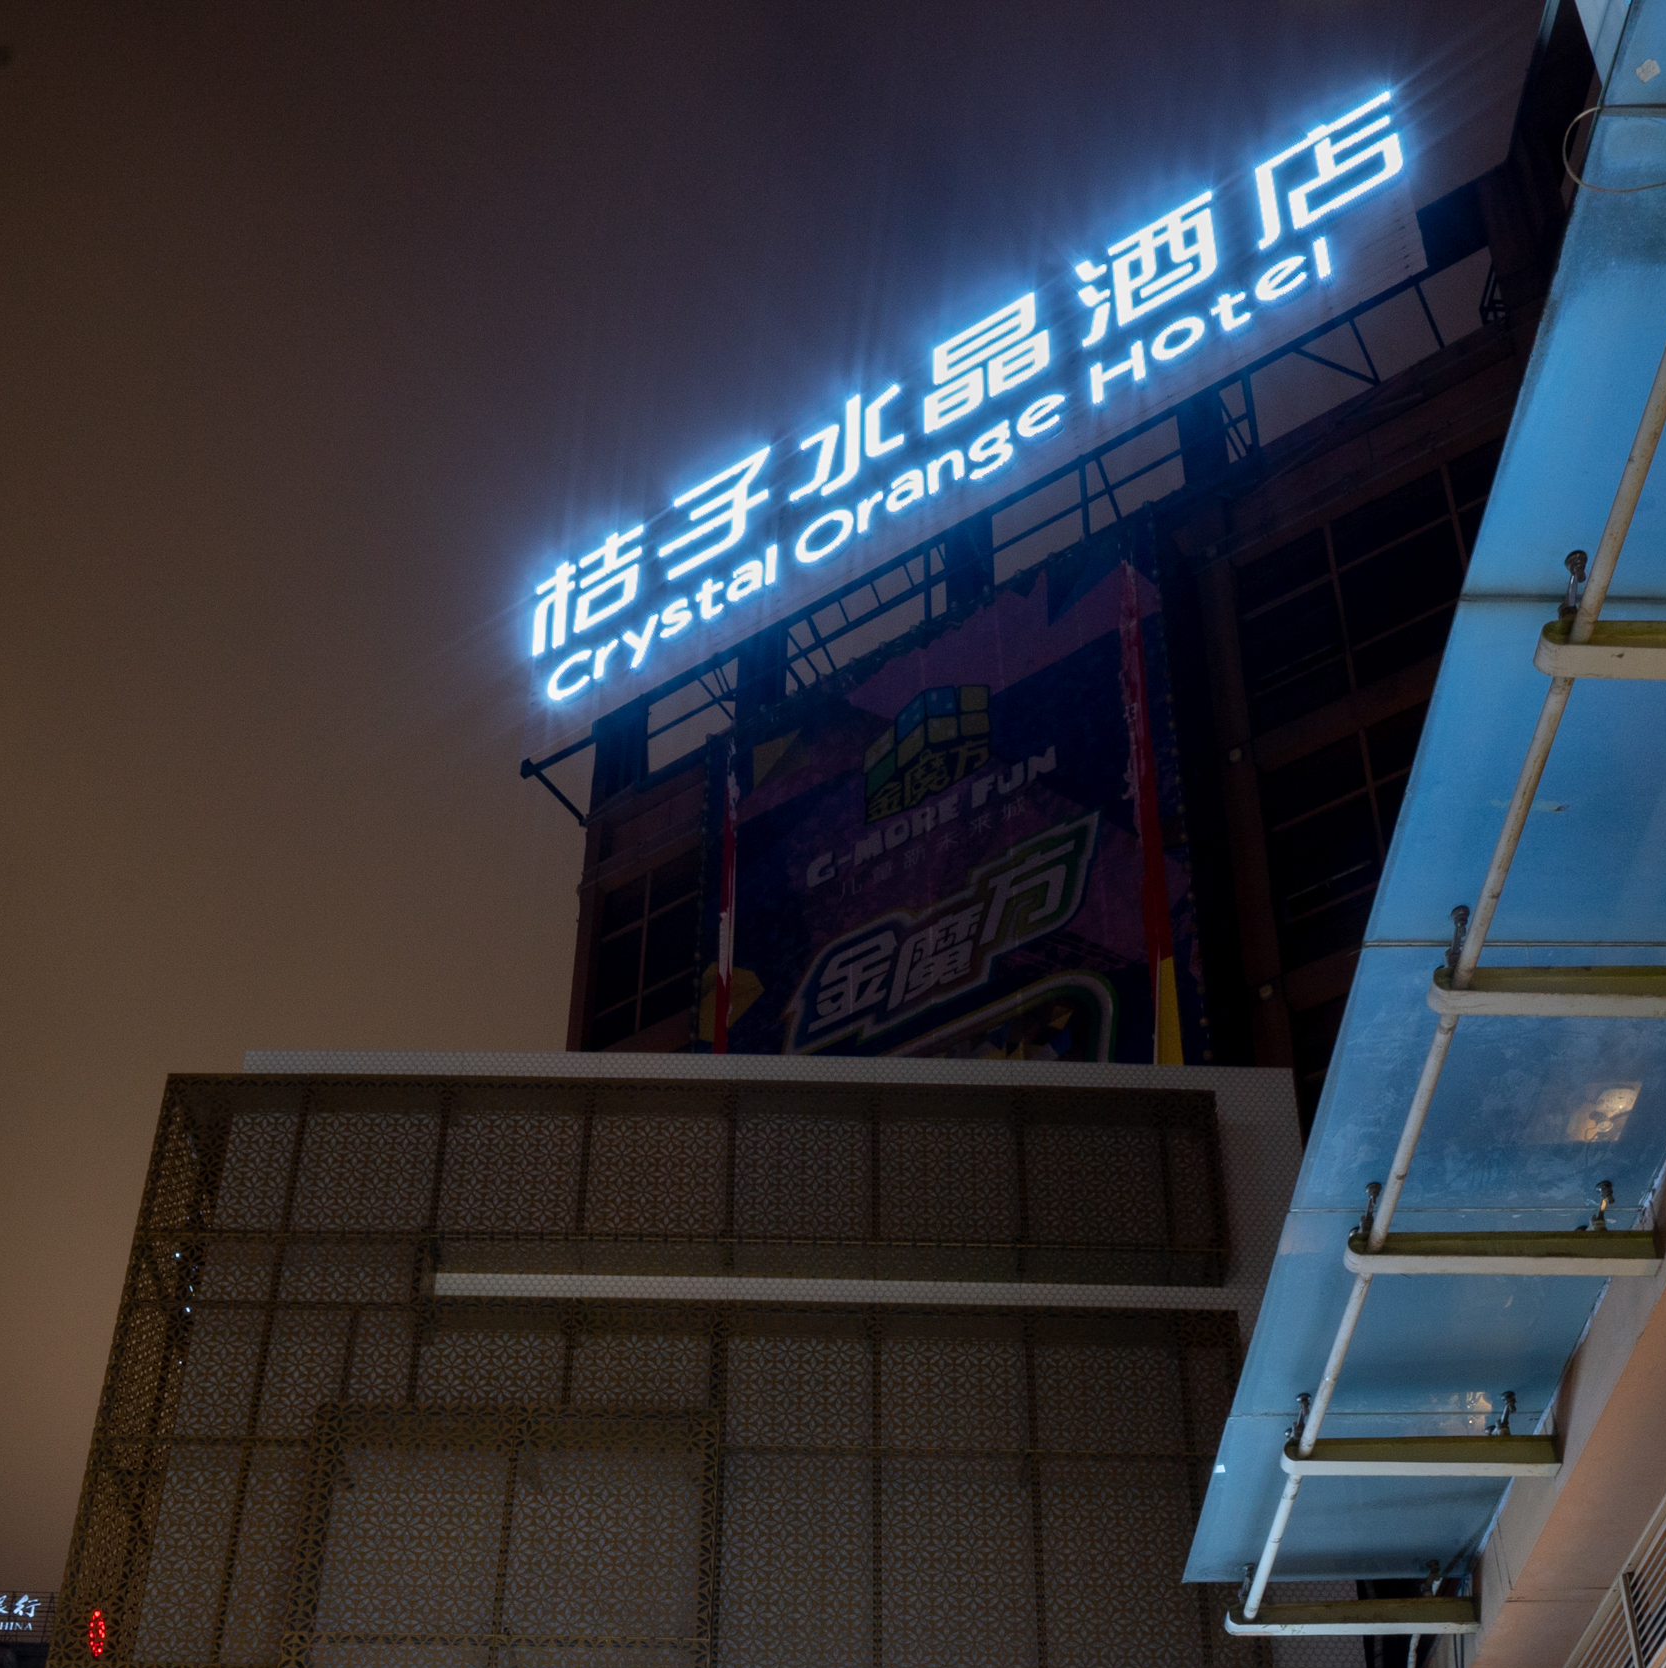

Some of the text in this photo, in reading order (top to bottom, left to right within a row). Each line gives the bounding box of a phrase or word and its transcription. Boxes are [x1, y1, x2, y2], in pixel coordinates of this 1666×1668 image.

[531, 90, 1405, 656] 桔子水晶酒店
[546, 237, 1332, 702] Crystal Orange Hotel
[806, 744, 1058, 889] G-MORE FUN
[807, 838, 1075, 1035] 金魔方
